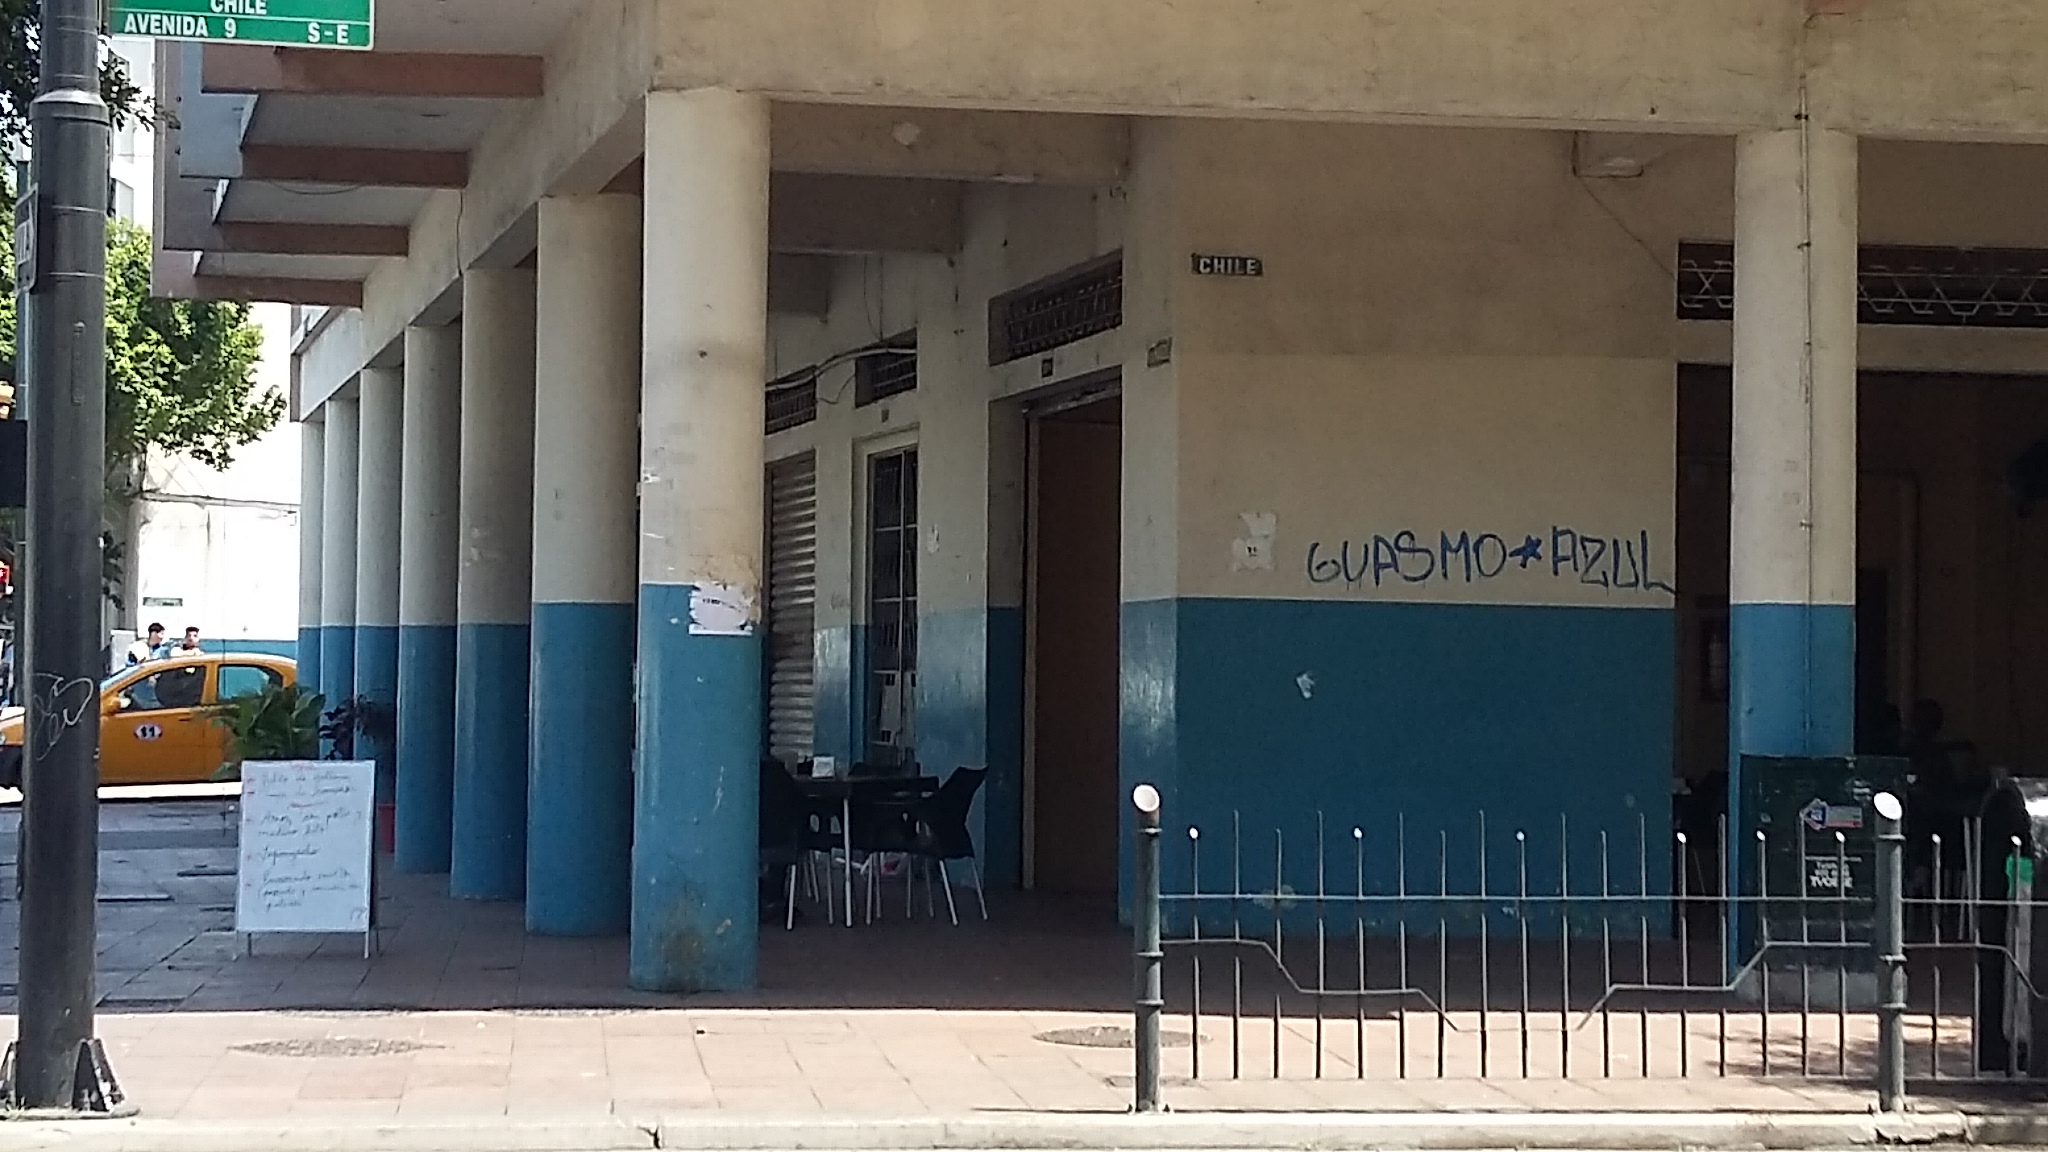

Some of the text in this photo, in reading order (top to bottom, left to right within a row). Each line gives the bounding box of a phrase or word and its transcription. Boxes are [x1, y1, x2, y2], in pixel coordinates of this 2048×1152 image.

[209, 0, 268, 15] CHILE
[124, 13, 209, 38] AVENIDA
[224, 17, 237, 38] 9
[1198, 256, 1257, 275] CHILE
[1306, 525, 1676, 595] GUASMO AZUL
